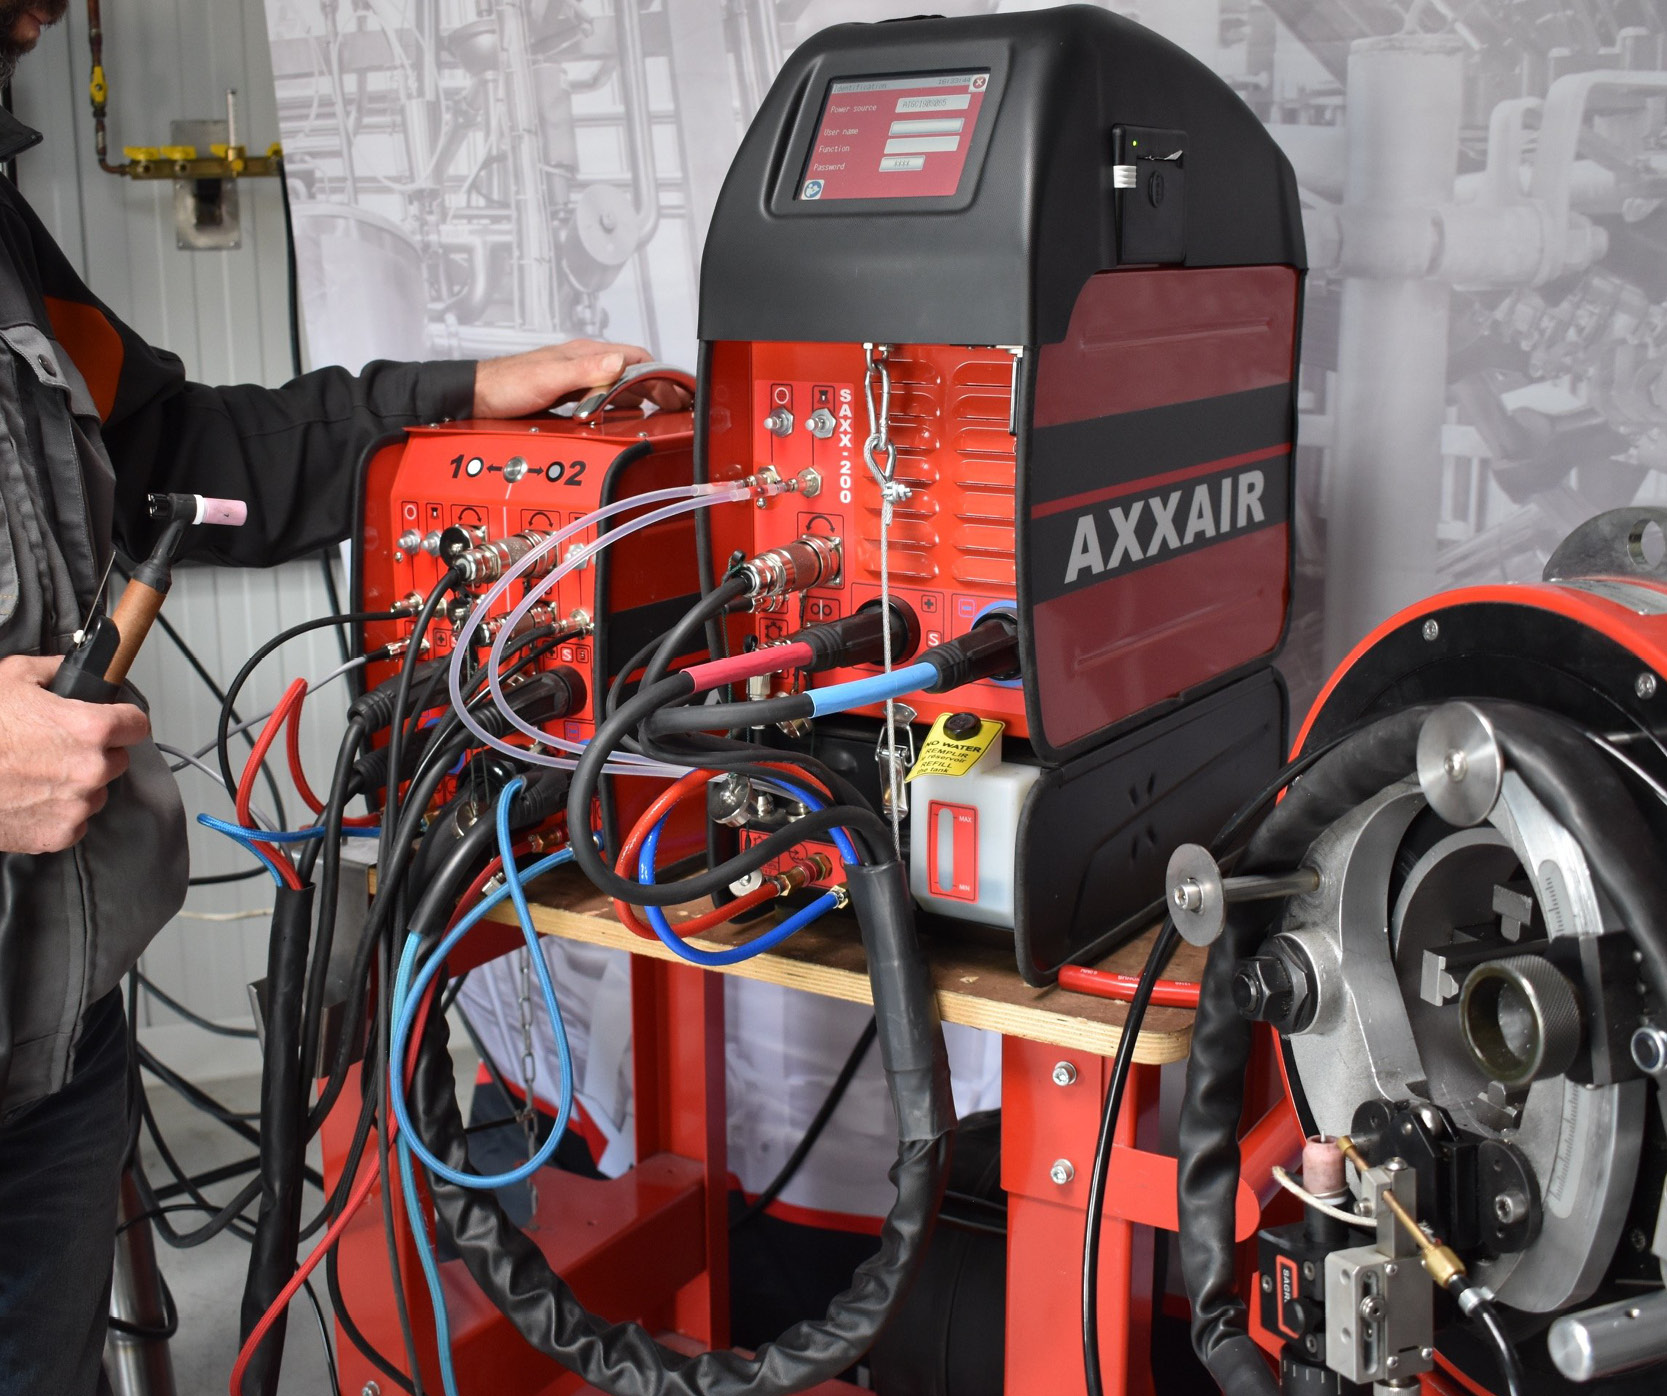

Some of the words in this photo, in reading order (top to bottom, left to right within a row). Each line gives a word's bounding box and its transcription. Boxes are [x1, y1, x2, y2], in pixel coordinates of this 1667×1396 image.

[830, 105, 852, 113] Power
[853, 104, 877, 112] source
[824, 128, 840, 136] User
[818, 145, 850, 153] Function
[813, 163, 845, 171] Password
[839, 388, 852, 504] SAXX-200
[450, 454, 465, 479] 1
[563, 460, 587, 486] 2
[1064, 469, 1265, 584] AXXAIR
[942, 741, 982, 753] WATER
[926, 747, 969, 758] REMPLIR
[927, 753, 967, 763] réservoir
[959, 815, 972, 823] MAX
[959, 883, 970, 891] MIN
